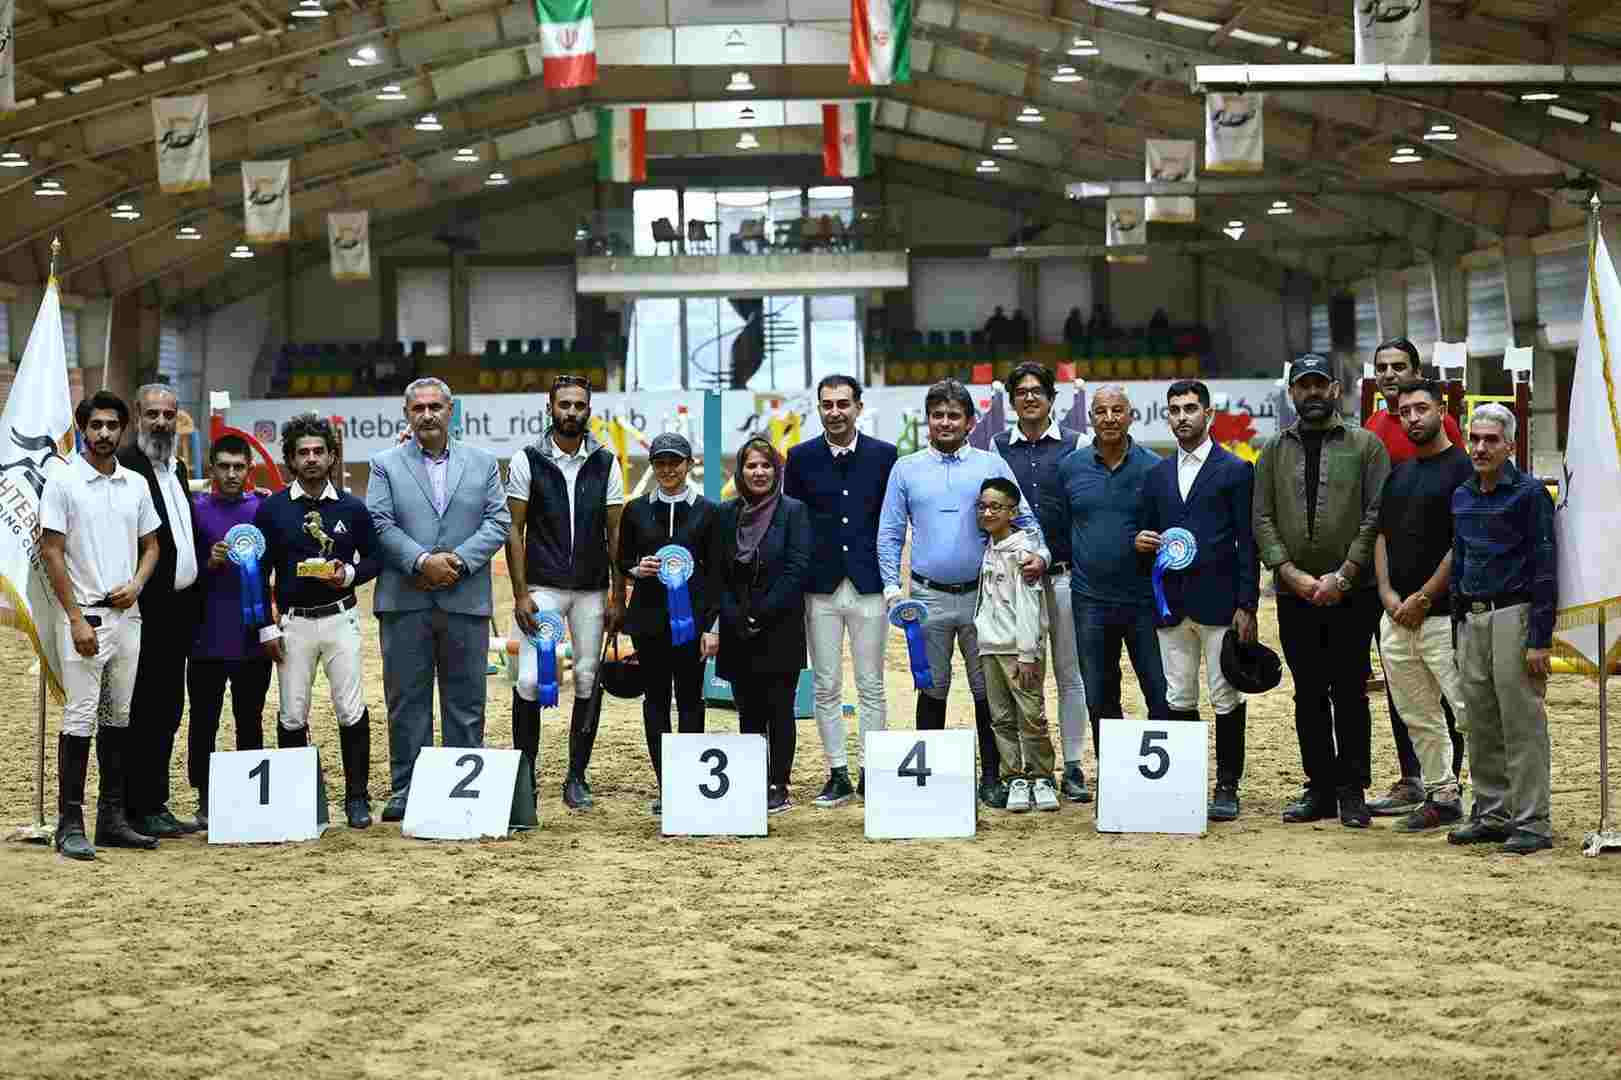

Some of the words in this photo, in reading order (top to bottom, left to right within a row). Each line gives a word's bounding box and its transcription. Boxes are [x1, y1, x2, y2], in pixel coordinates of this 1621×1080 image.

[449, 754, 483, 799] 2
[699, 749, 730, 799] 3
[898, 741, 932, 787] 4
[1139, 731, 1170, 779] 5
[249, 759, 269, 805] 1
